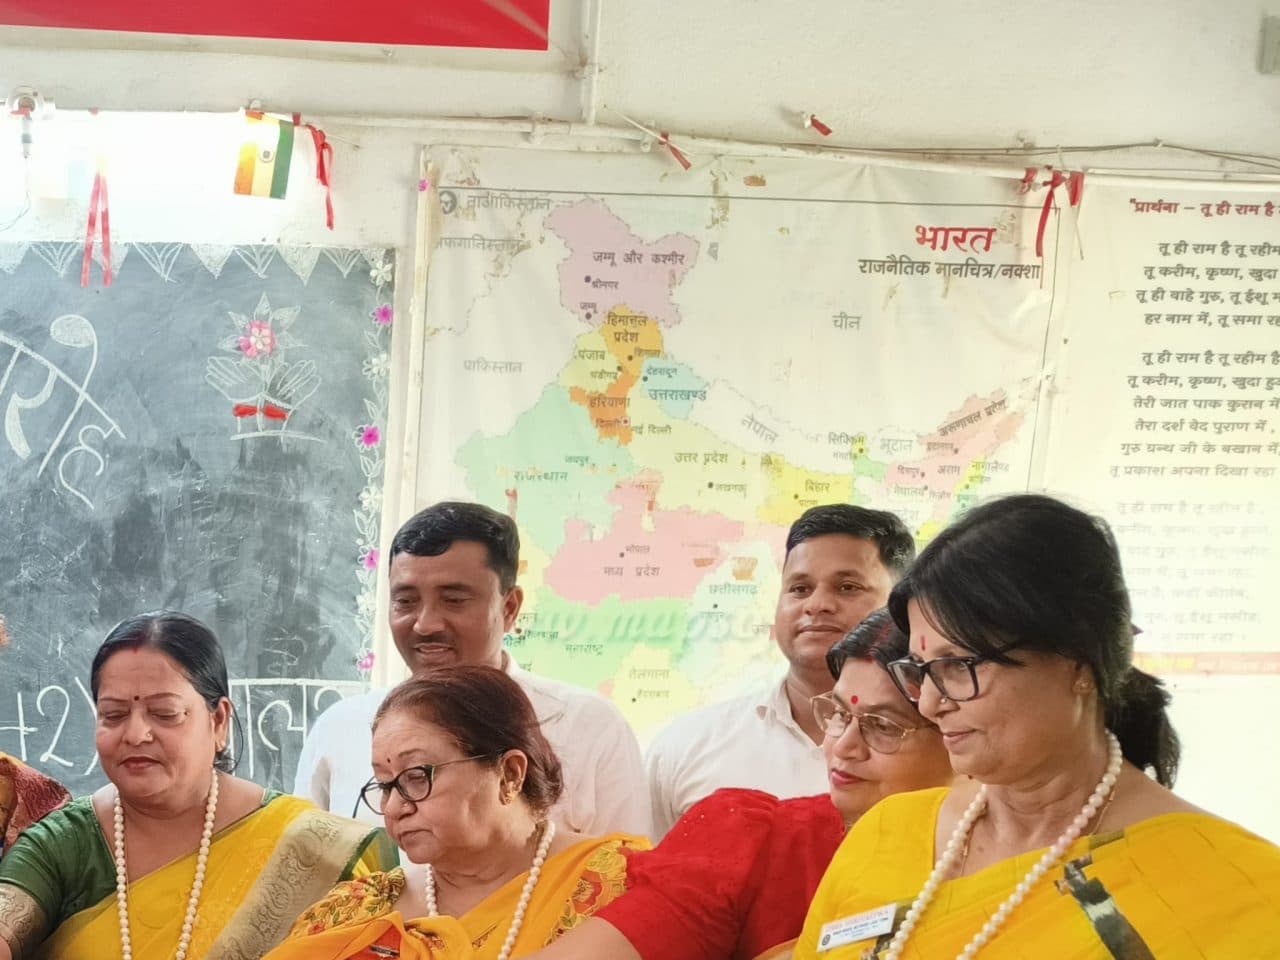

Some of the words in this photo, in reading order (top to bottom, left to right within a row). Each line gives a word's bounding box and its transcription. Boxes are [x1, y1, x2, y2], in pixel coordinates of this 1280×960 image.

[1235, 204, 1261, 215] राम
[1264, 201, 1275, 217] है
[915, 225, 997, 252] भारत
[623, 249, 643, 264] और
[650, 250, 685, 265] कश्मीर
[1159, 242, 1171, 256] तू
[1174, 240, 1188, 254] ही
[1192, 243, 1217, 255] राम
[1220, 240, 1231, 256] है
[1235, 245, 1247, 258] तू
[858, 254, 931, 276] राजनैतिक
[1144, 266, 1156, 279] तू
[1136, 289, 1147, 303] तू
[1151, 286, 1165, 301] ही
[1230, 291, 1241, 305] तू
[1145, 312, 1161, 326] हर
[1165, 313, 1192, 325] नाम
[1218, 314, 1230, 328] तू
[1232, 315, 1263, 326] समा
[1142, 352, 1154, 366] तू
[1157, 350, 1171, 363] ही
[1175, 353, 1200, 364] राम
[1204, 350, 1215, 365] है
[1219, 353, 1231, 367] तू
[1233, 351, 1267, 365] रहीम
[1127, 375, 1139, 388] तू
[1133, 395, 1156, 408] तेरी
[1193, 398, 1222, 409] पाक
[1135, 418, 1157, 431] तेरा
[1213, 421, 1251, 434] पुराण
